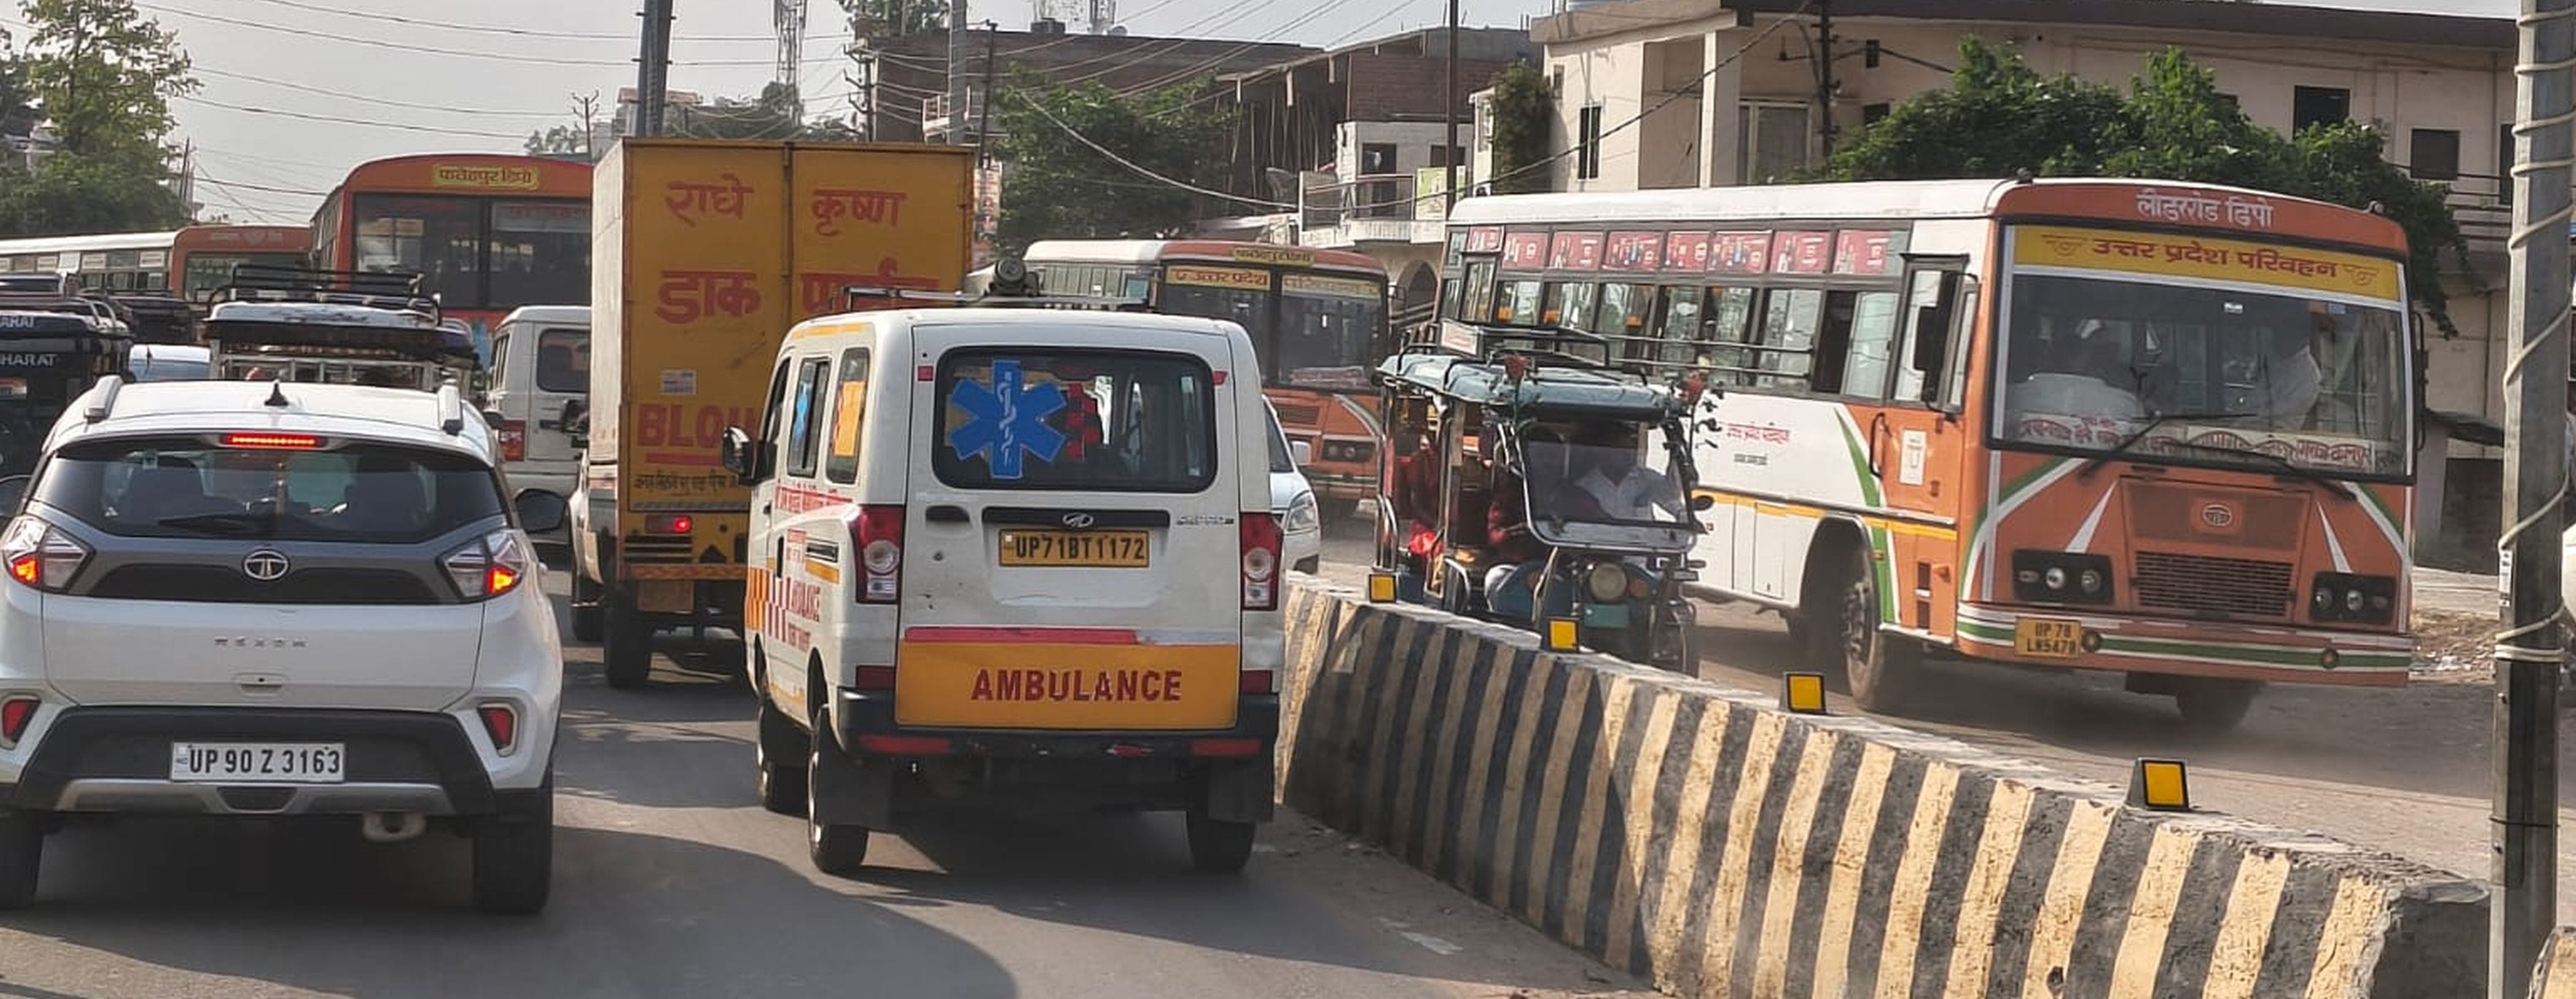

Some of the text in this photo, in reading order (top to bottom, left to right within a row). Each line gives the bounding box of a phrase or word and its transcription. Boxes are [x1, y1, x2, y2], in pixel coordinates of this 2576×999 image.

[666, 173, 908, 237] राधे कृष्ण
[2225, 195, 2274, 229] डिपो
[2093, 238, 2338, 277] उत्तर प्रदेश परिवहन
[654, 270, 761, 324] डाक
[0, 353, 57, 366] HARAT
[971, 669, 1183, 702] AMBULANCE
[190, 749, 340, 774] UP 90 Z 3163
